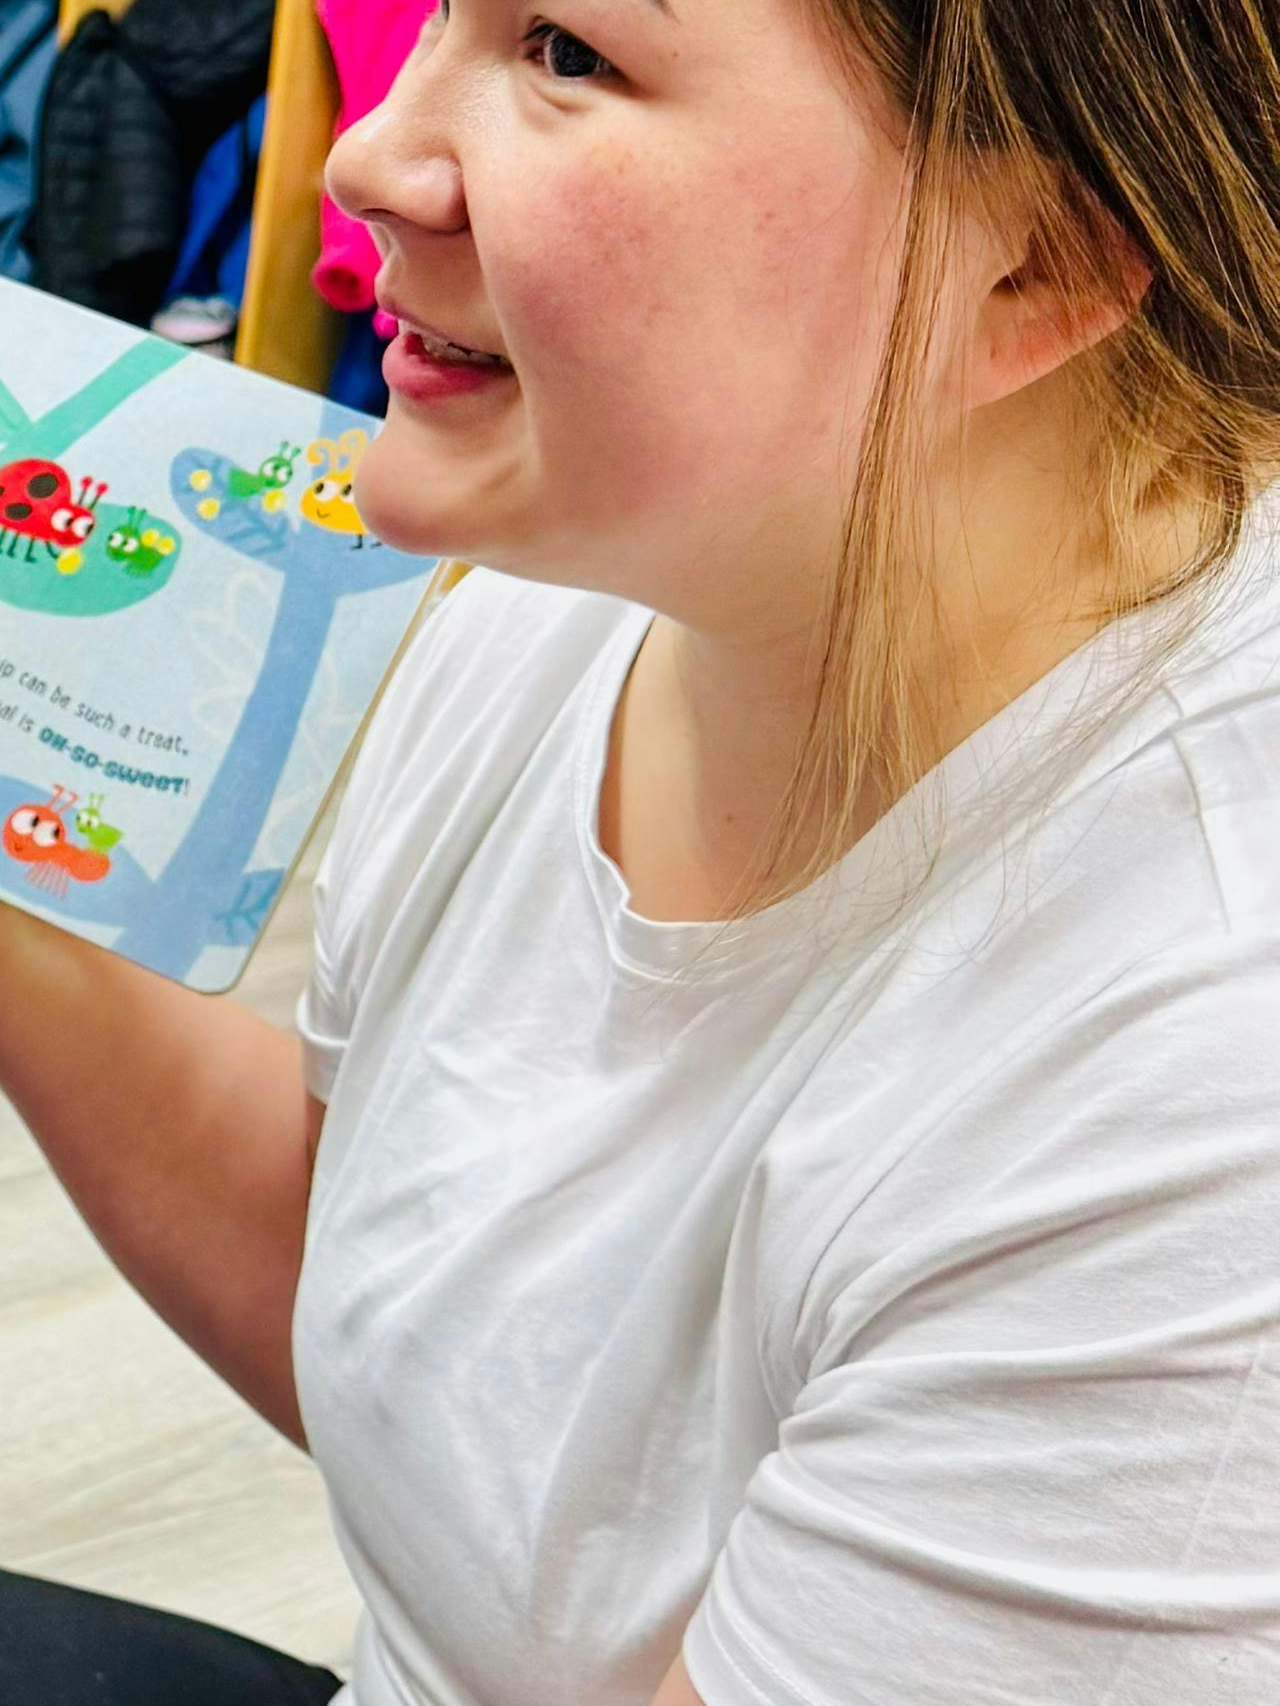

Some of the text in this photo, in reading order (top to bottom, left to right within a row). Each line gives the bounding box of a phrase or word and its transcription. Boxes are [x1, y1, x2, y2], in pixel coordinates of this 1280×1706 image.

[17, 712, 35, 734] is
[18, 671, 48, 697] can
[49, 685, 71, 710] be
[74, 702, 115, 731] such
[118, 723, 131, 739] a
